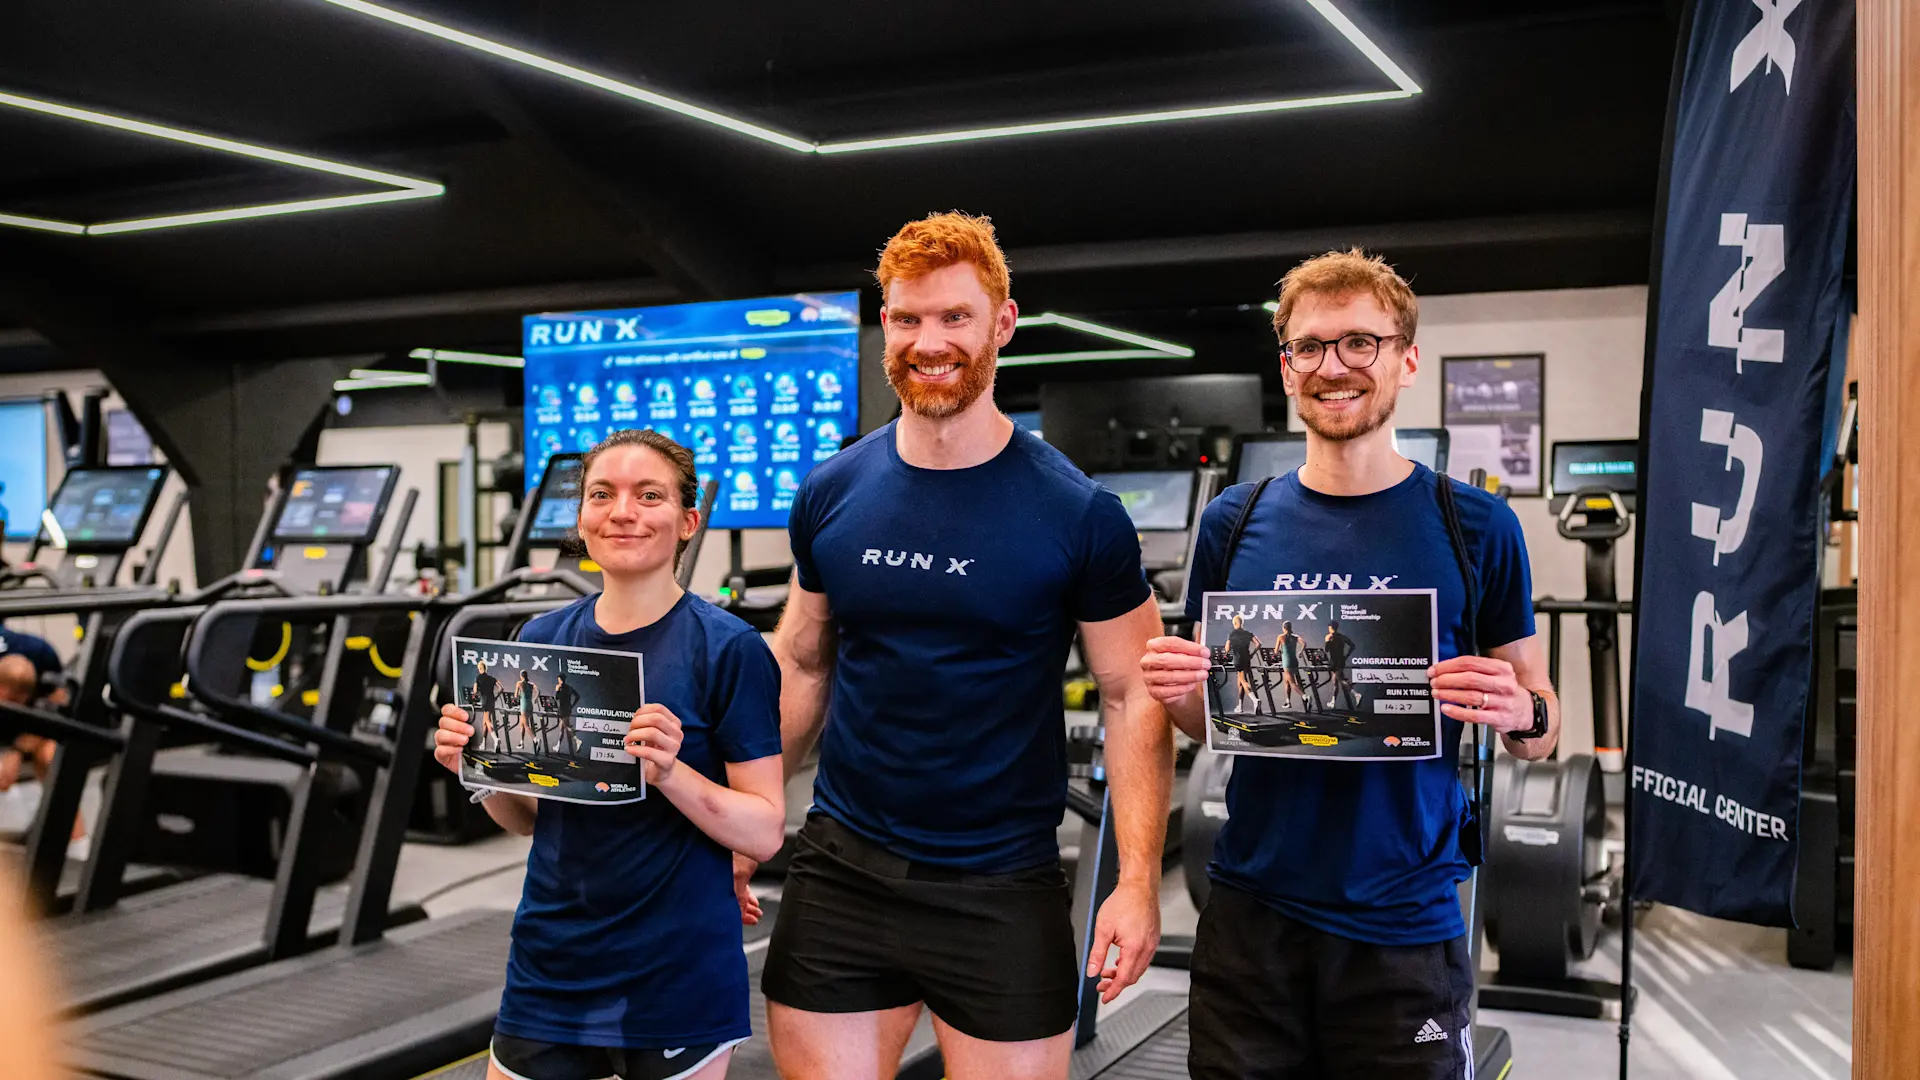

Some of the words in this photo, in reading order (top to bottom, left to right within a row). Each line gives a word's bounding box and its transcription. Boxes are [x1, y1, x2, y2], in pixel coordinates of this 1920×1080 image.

[1730, 0, 1800, 95] X
[530, 319, 603, 345] RUN
[1685, 213, 1785, 740] RUN
[861, 549, 934, 570] RUN
[1273, 574, 1352, 590] RUN
[1214, 604, 1284, 620] RUN
[462, 650, 520, 668] RUN
[568, 668, 600, 676] Championship
[577, 707, 634, 718] CONGRATULATION
[1632, 765, 1710, 814] FFICIAL
[1715, 794, 1789, 841] CENTER
[1414, 1032, 1448, 1043] adidas
